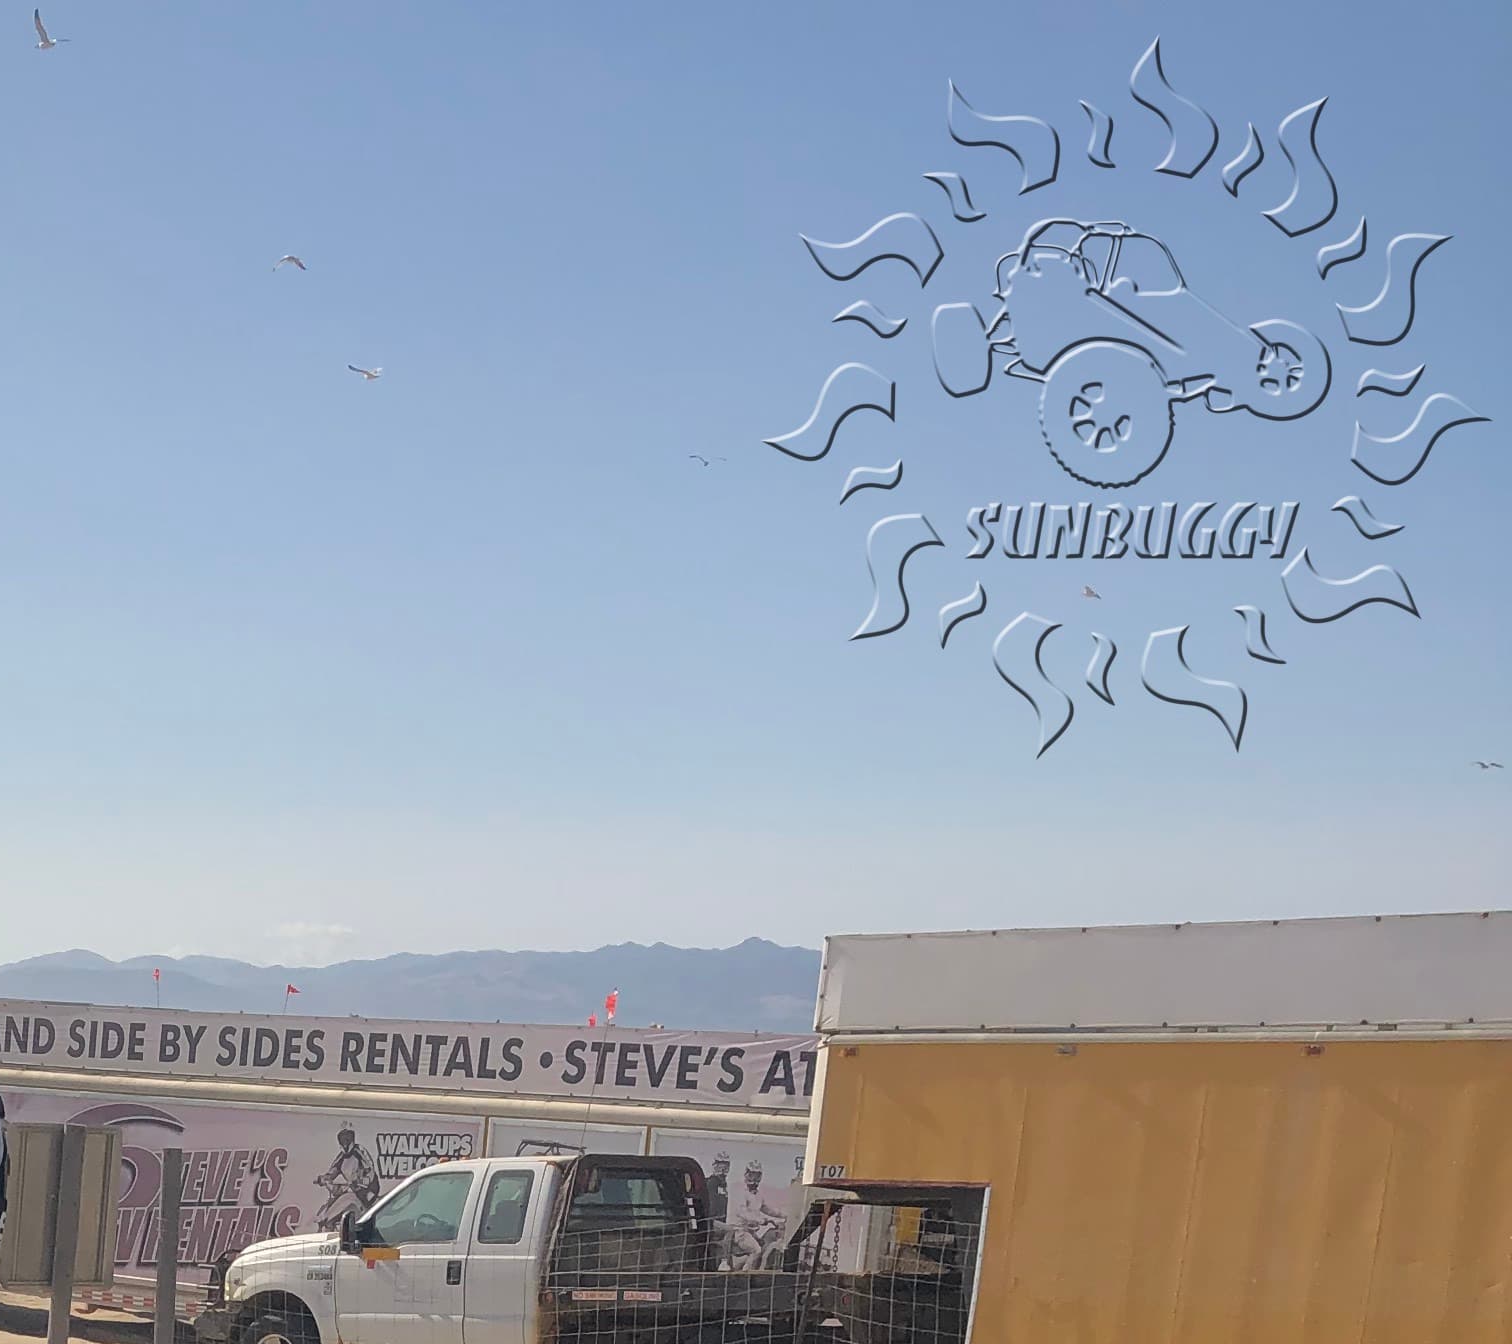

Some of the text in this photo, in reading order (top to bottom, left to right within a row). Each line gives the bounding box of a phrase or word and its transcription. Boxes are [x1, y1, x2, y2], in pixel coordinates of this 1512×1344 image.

[67, 1019, 146, 1061] SIDE
[159, 1024, 207, 1065] BY
[216, 1026, 326, 1071] SIDES
[339, 1031, 524, 1082] RENTALS
[561, 1039, 745, 1094] STEVE'S
[376, 1133, 472, 1156] WALK-UPS
[820, 1165, 845, 1178] T07
